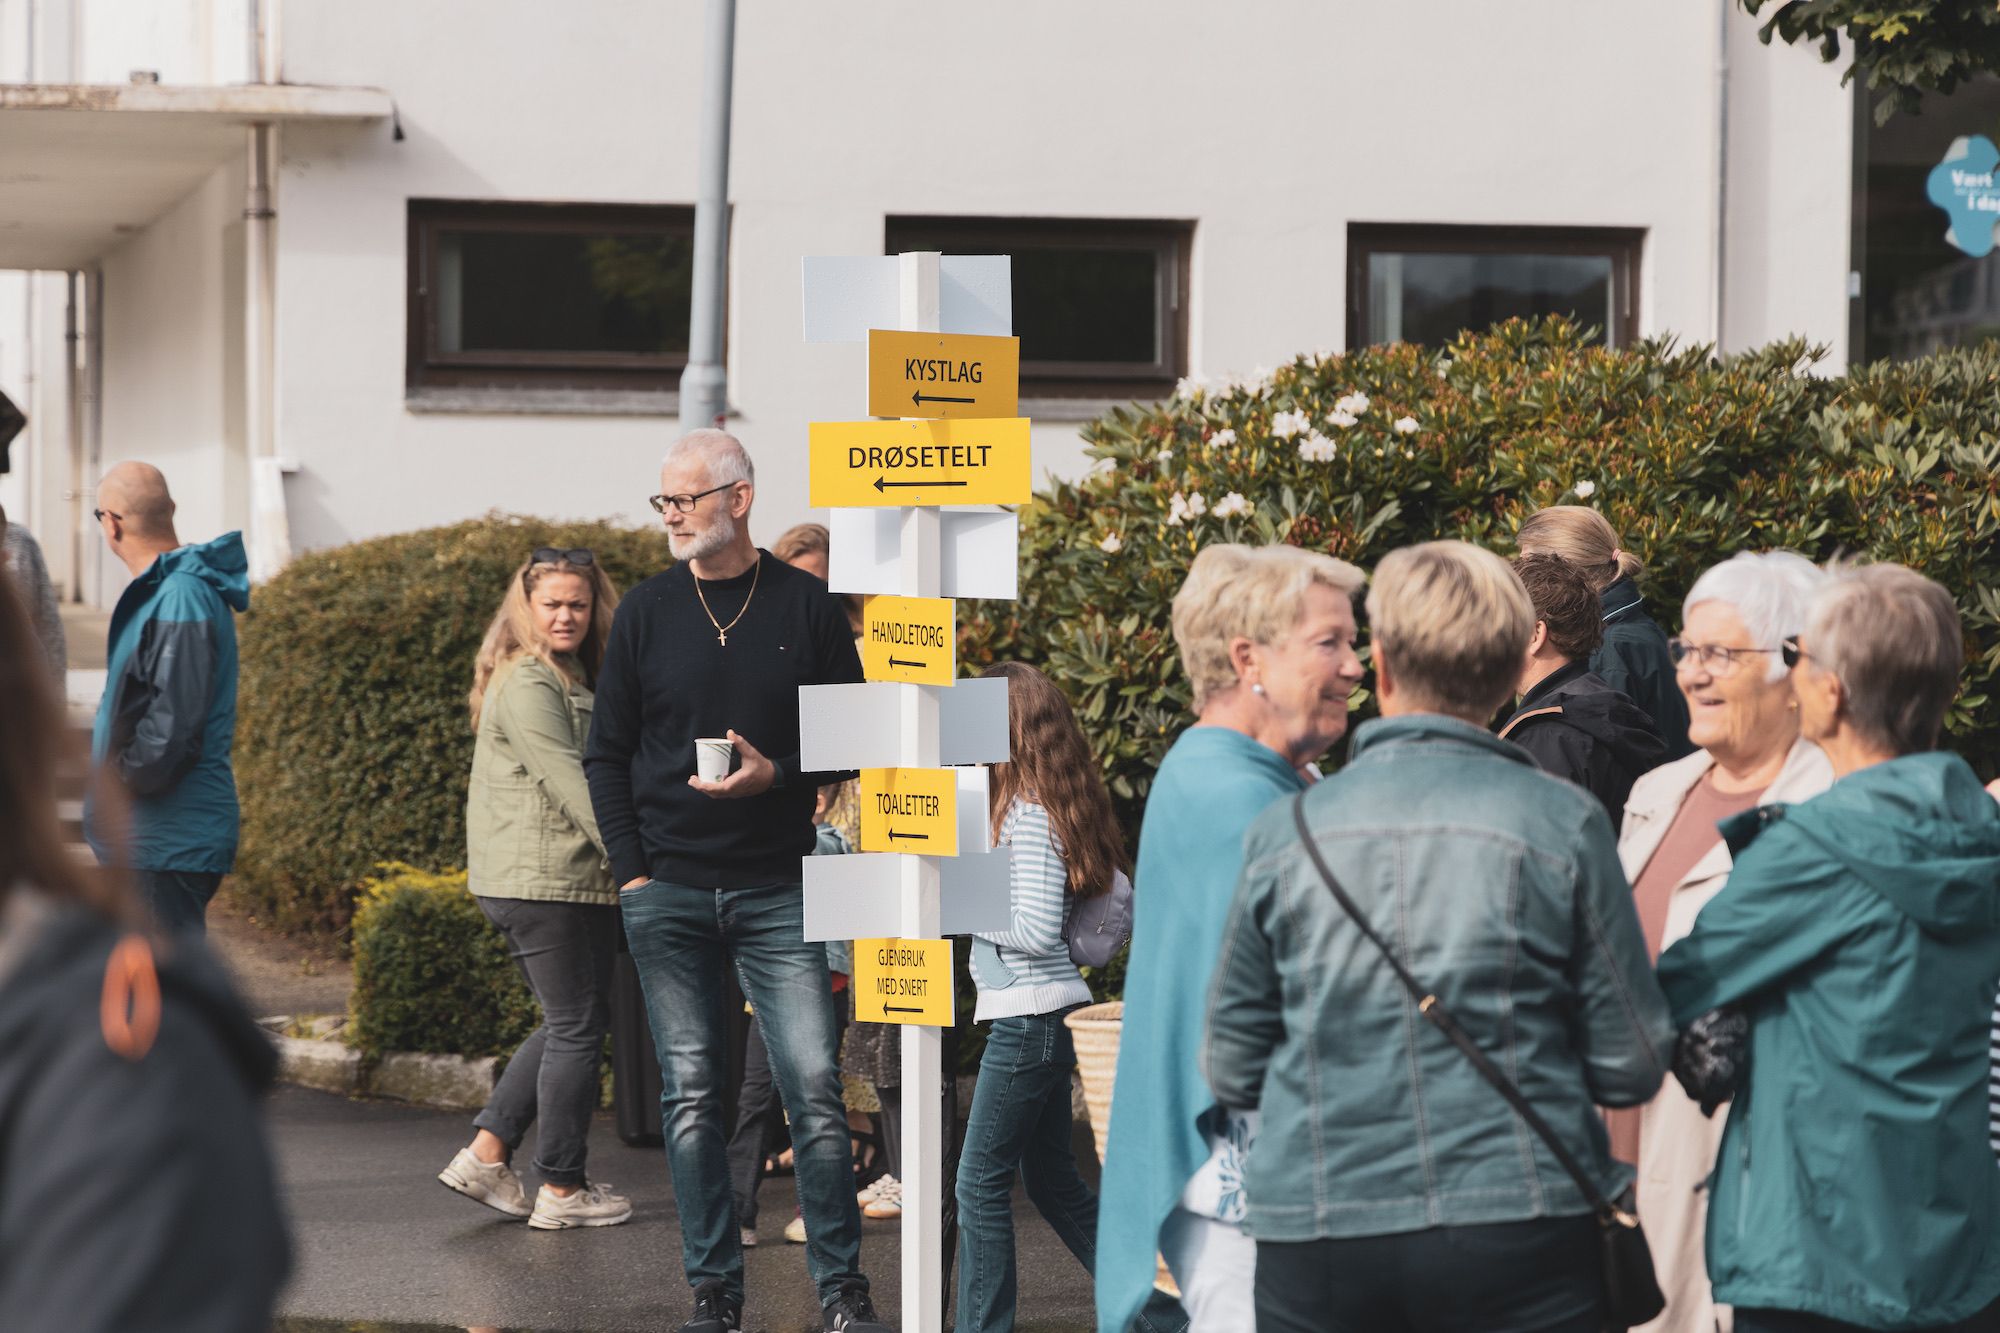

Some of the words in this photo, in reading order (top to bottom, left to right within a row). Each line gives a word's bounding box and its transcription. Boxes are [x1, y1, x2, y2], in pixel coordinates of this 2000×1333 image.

[905, 358, 983, 384] KYSTLAG
[848, 445, 993, 469] DRØSETELT
[871, 621, 945, 649] HANDLETORG
[876, 793, 940, 817] TOALETTER
[877, 948, 926, 968] GJENBRUK
[876, 977, 897, 995] MED
[899, 978, 928, 997] SNERT
